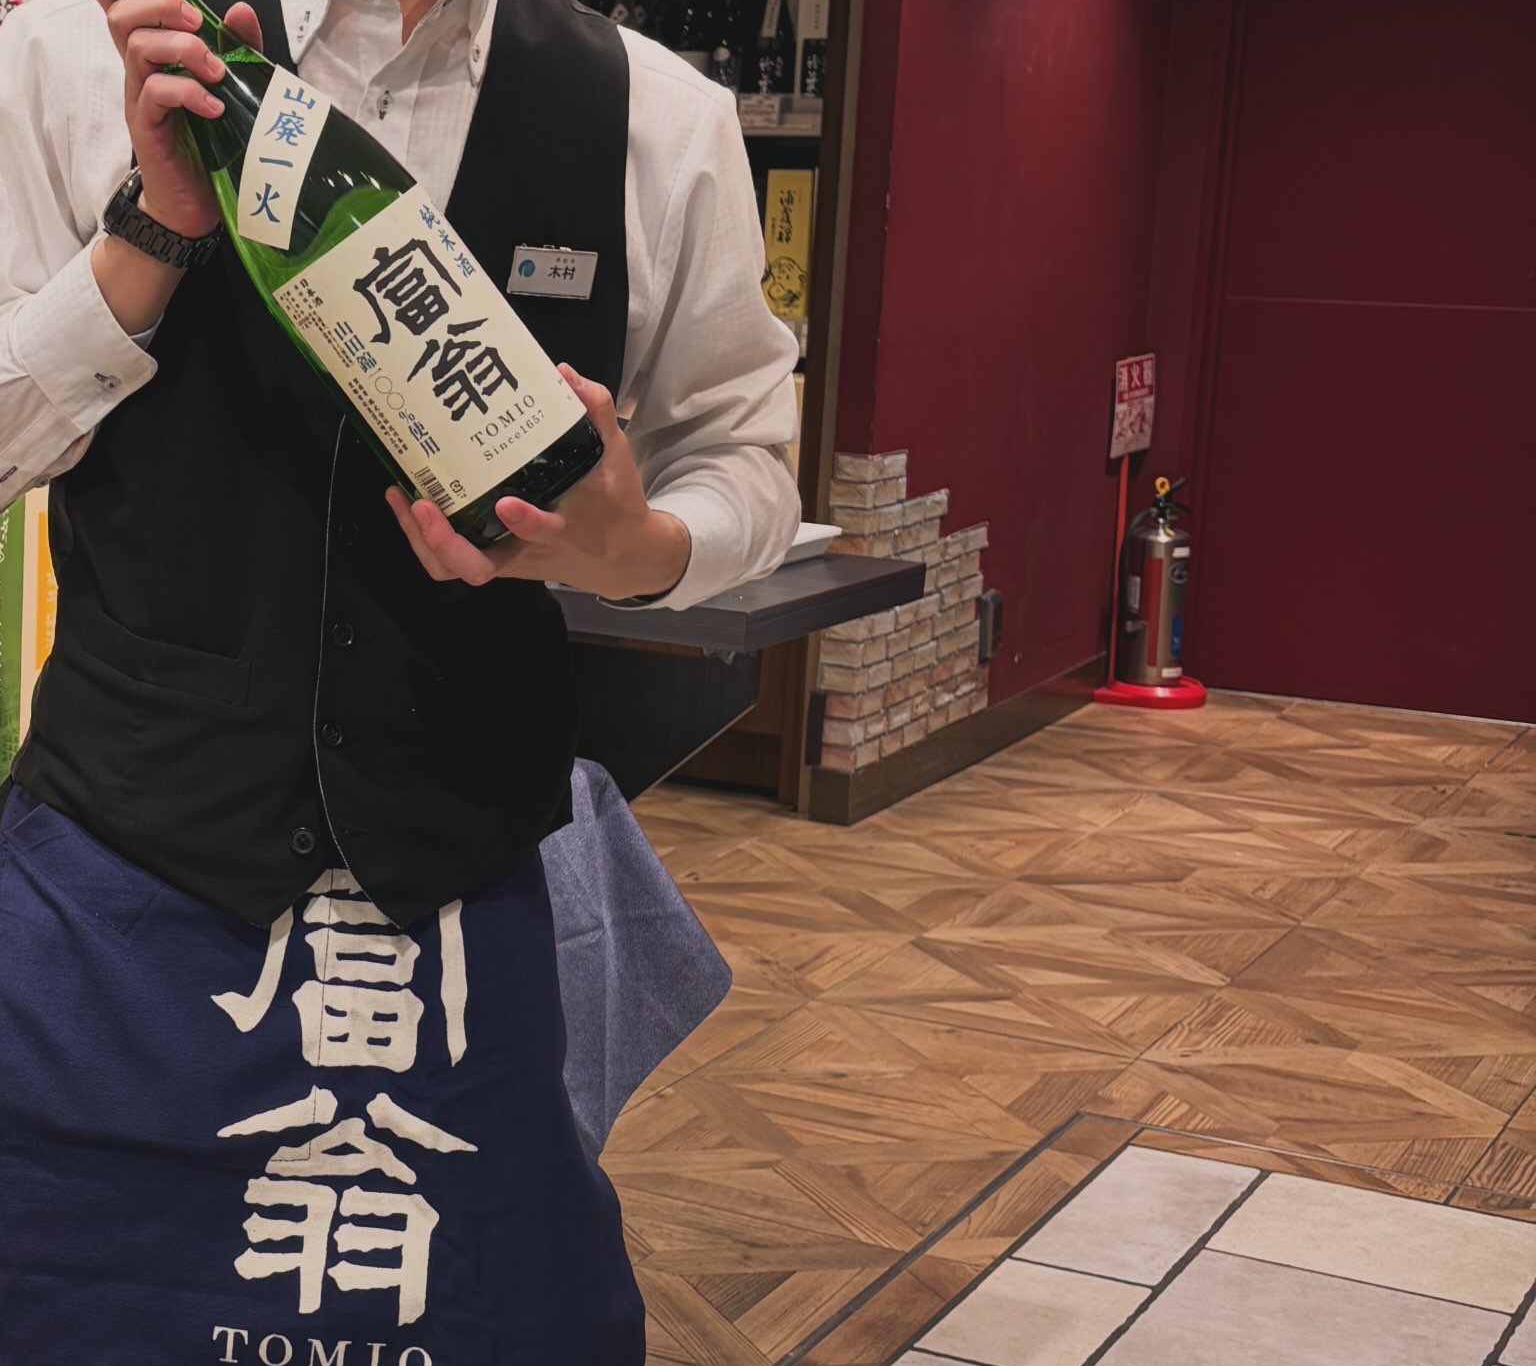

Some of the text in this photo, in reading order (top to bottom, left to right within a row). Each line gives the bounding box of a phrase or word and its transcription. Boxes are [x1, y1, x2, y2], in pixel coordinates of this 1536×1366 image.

[248, 85, 316, 225] 山廃一火
[417, 204, 478, 281] 純米酒
[547, 264, 576, 282] 木村
[352, 236, 520, 424] 富翁
[469, 393, 537, 448] TOMIO
[481, 408, 547, 463] Since1657
[210, 867, 479, 1327] 富翁
